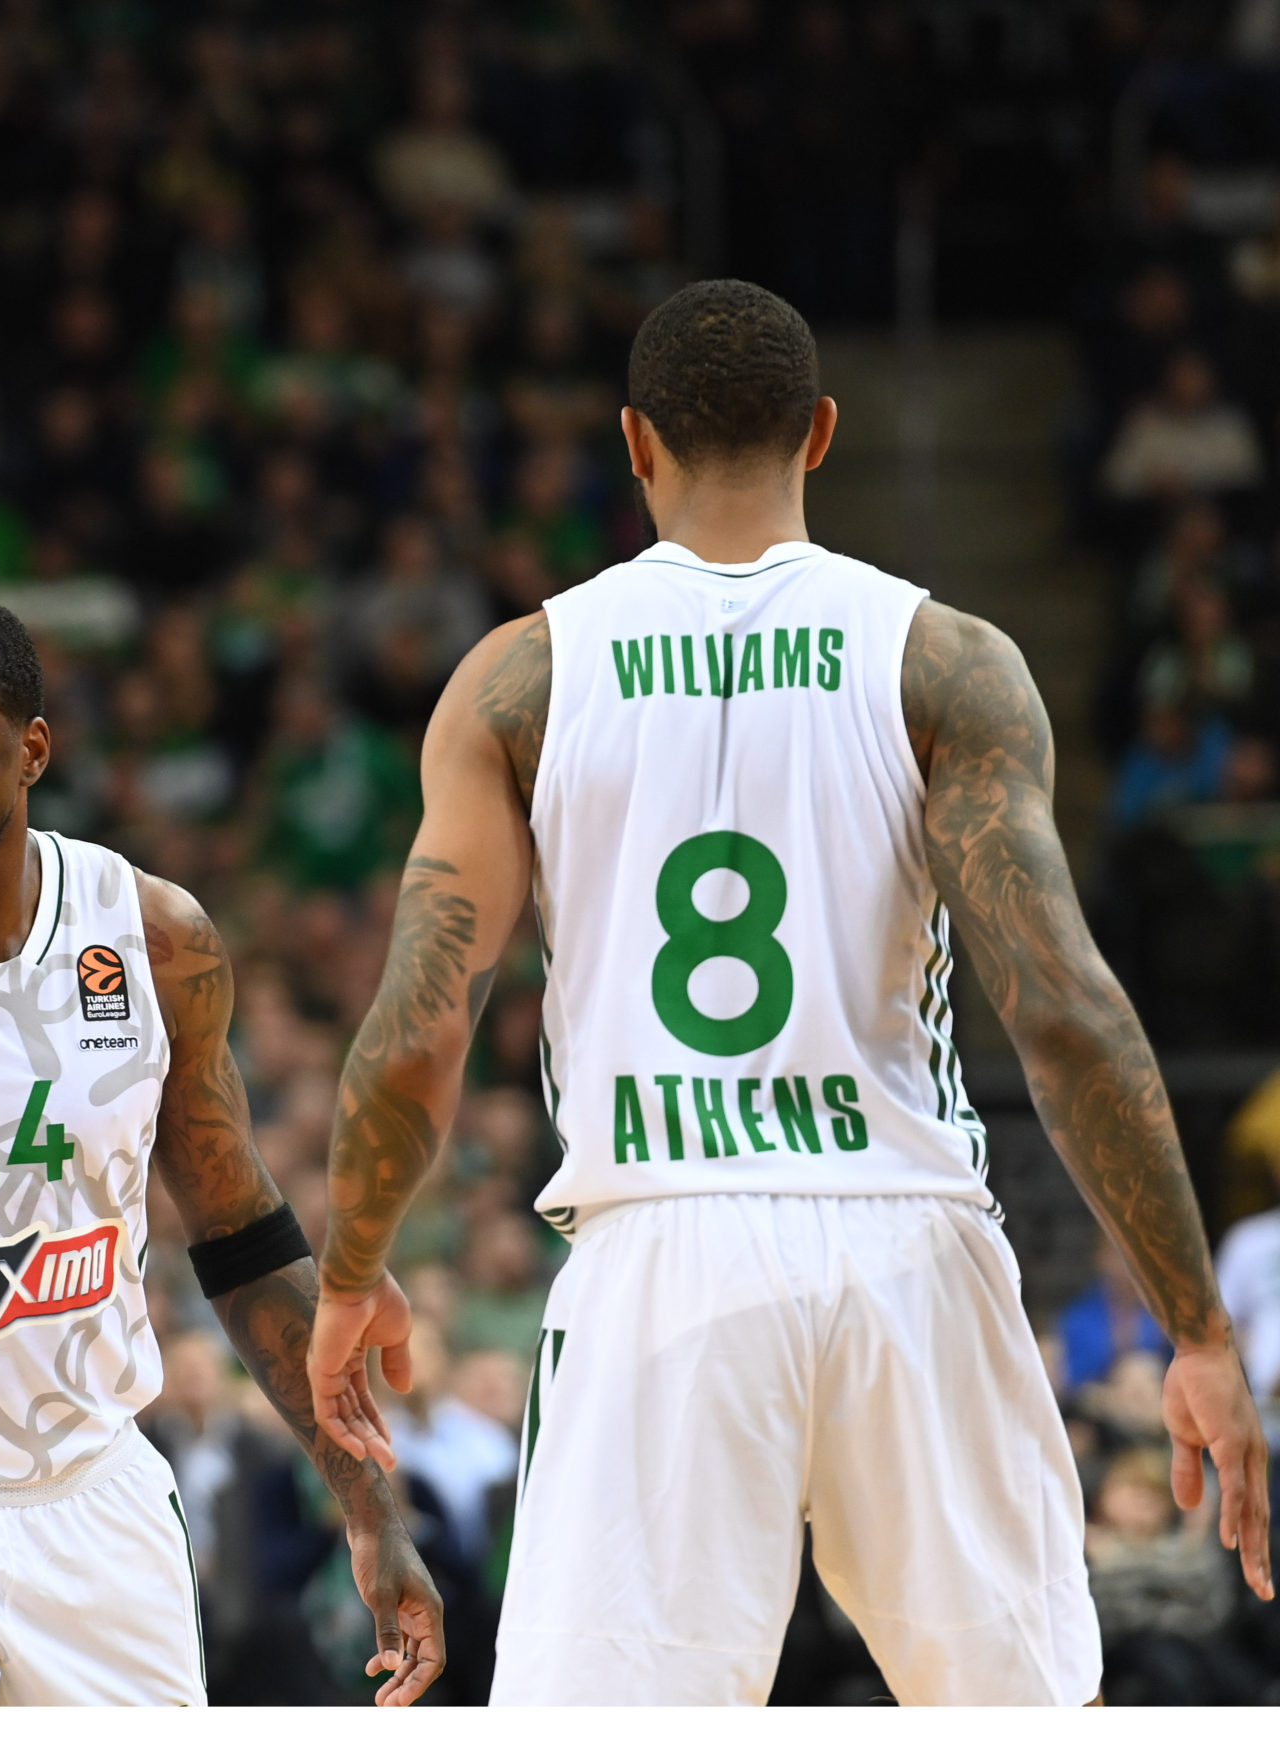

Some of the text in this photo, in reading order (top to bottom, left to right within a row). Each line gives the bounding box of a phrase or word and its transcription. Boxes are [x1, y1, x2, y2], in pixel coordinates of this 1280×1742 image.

[611, 626, 844, 700] WILLIAMS
[651, 830, 794, 1057] 8
[85, 995, 124, 1003] TURKISH
[87, 1002, 125, 1011] AIRLINES
[615, 1074, 869, 1165] ATHENS
